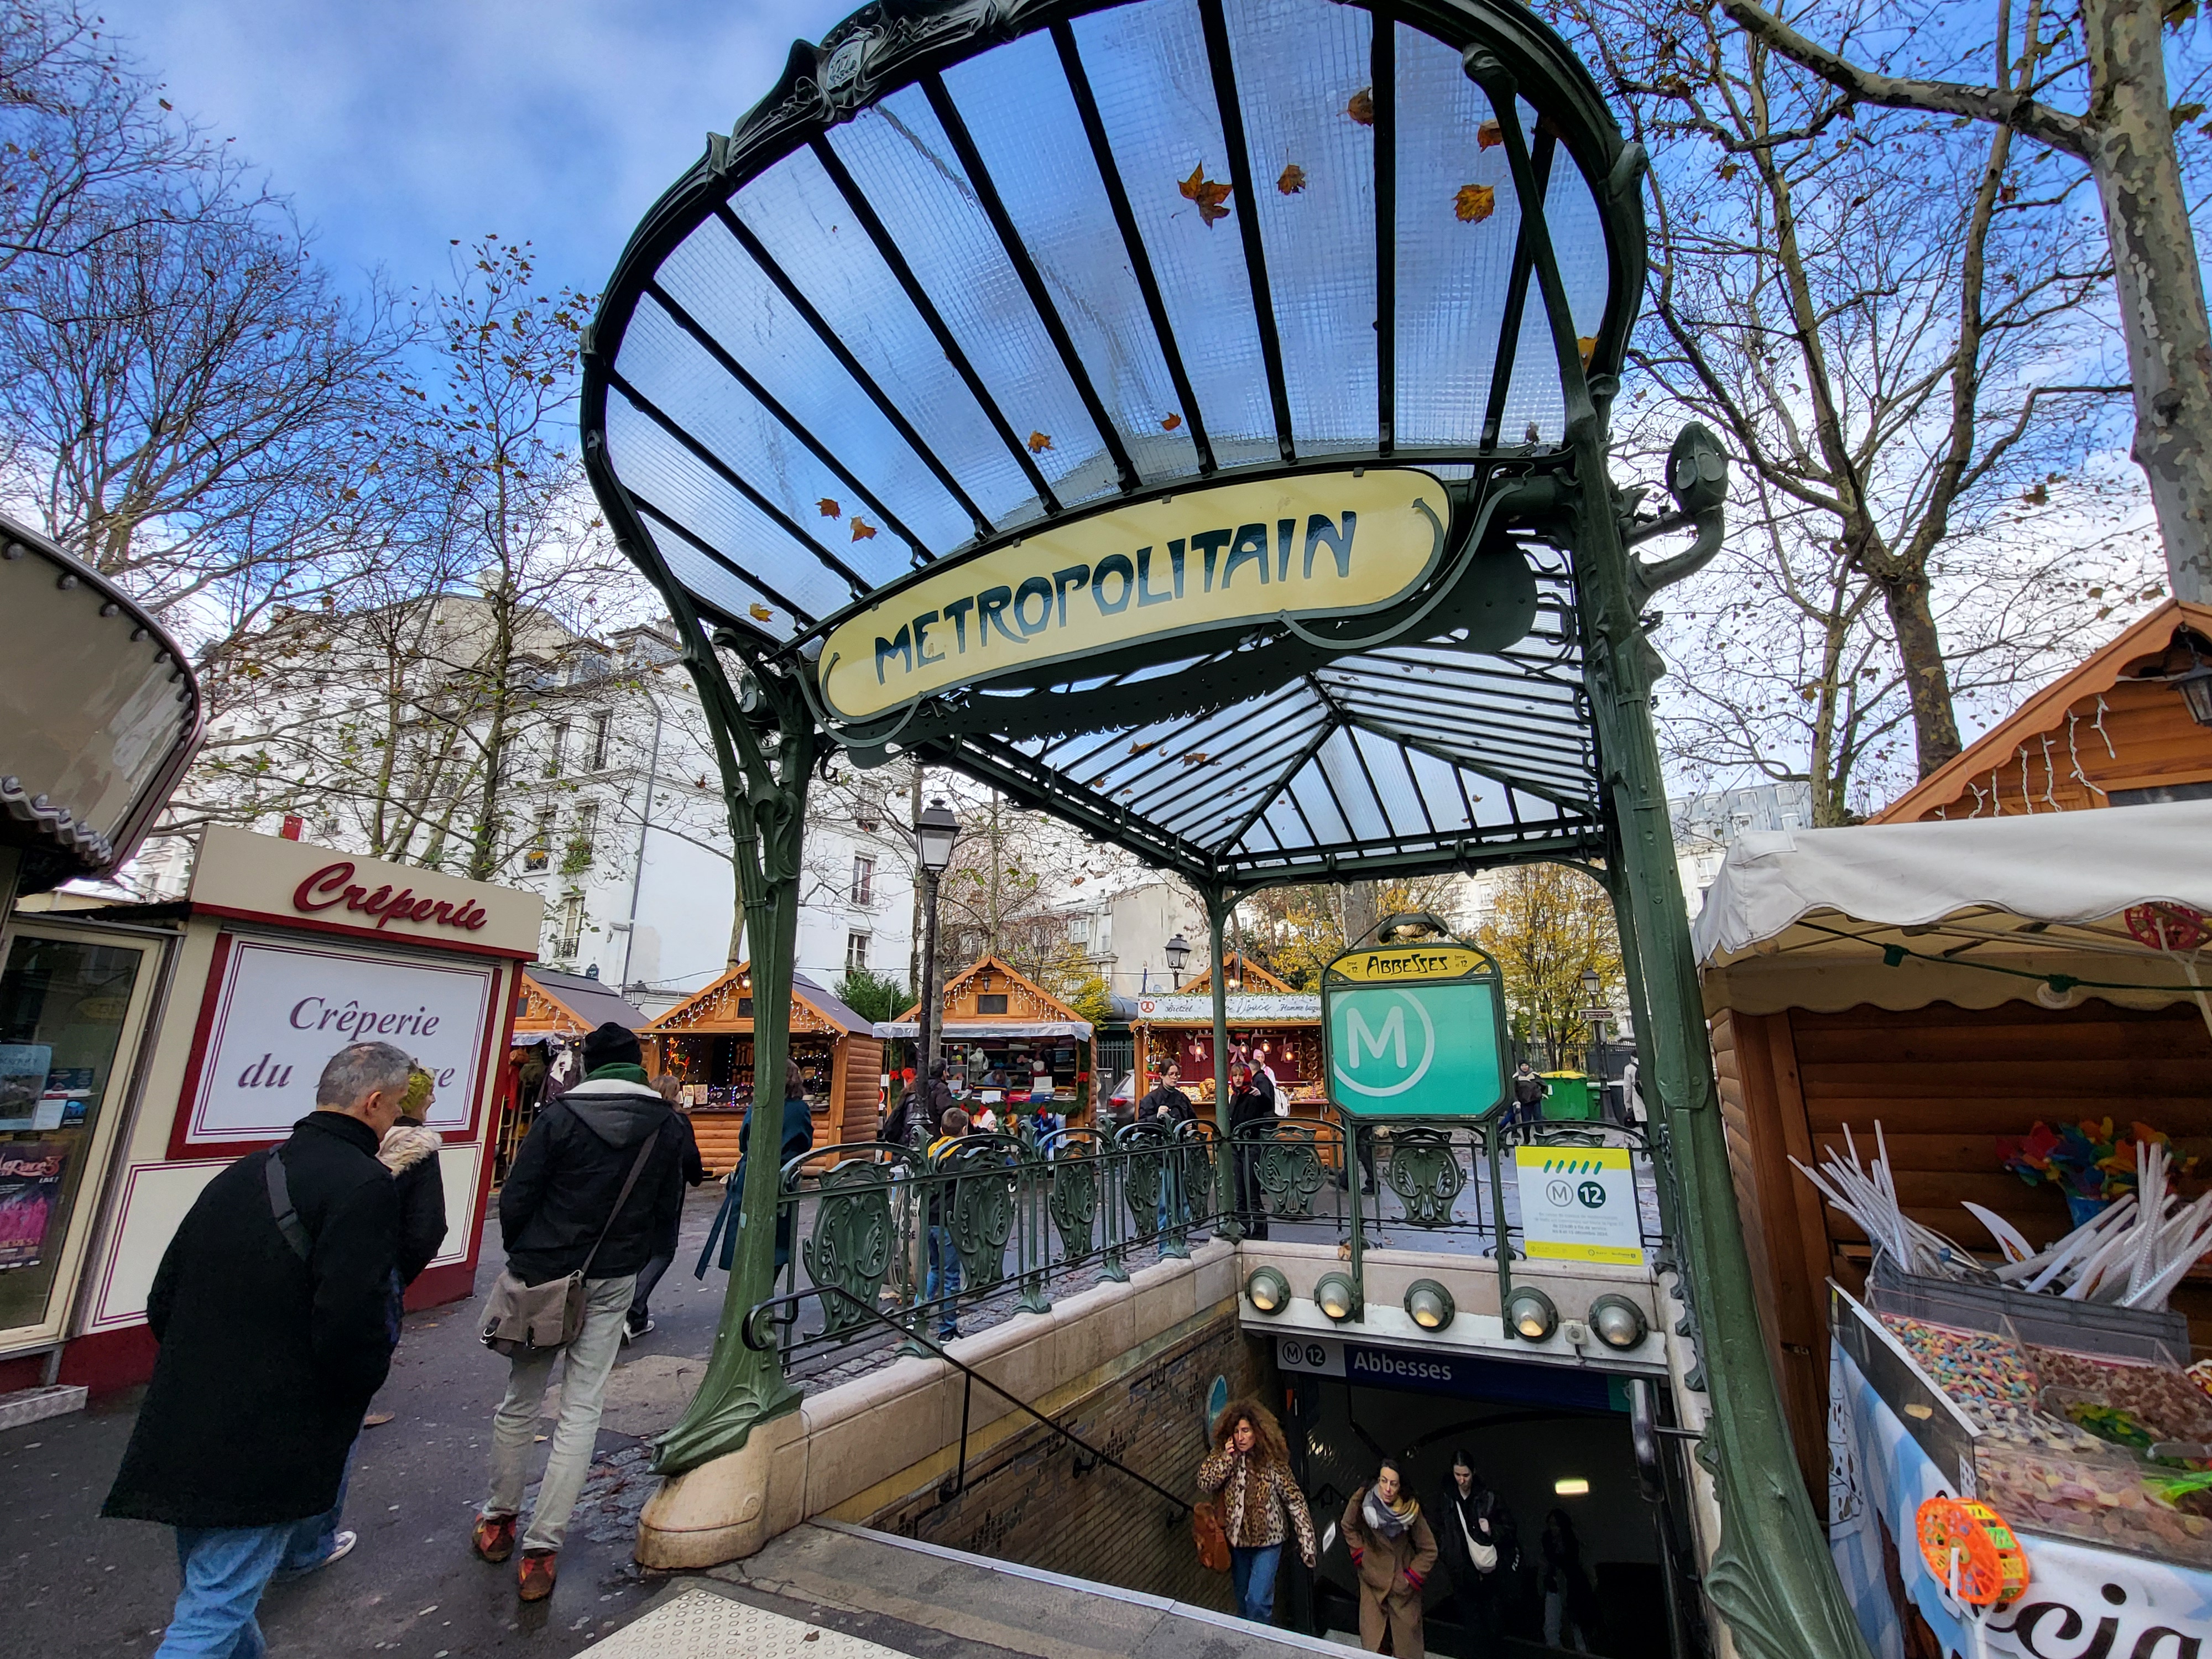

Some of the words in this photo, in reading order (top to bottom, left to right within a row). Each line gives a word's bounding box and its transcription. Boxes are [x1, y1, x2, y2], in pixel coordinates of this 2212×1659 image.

[875, 511, 1357, 685] METROPOLITAIN
[293, 862, 488, 930] Crêperie
[1366, 953, 1448, 978] ABBESSES
[290, 997, 440, 1042] Crêperie
[1346, 1006, 1407, 1068] M
[238, 1053, 294, 1088] du
[1580, 1186, 1603, 1203] 12
[1308, 1348, 1324, 1361] 12
[1354, 1351, 1452, 1381] Abbesses
